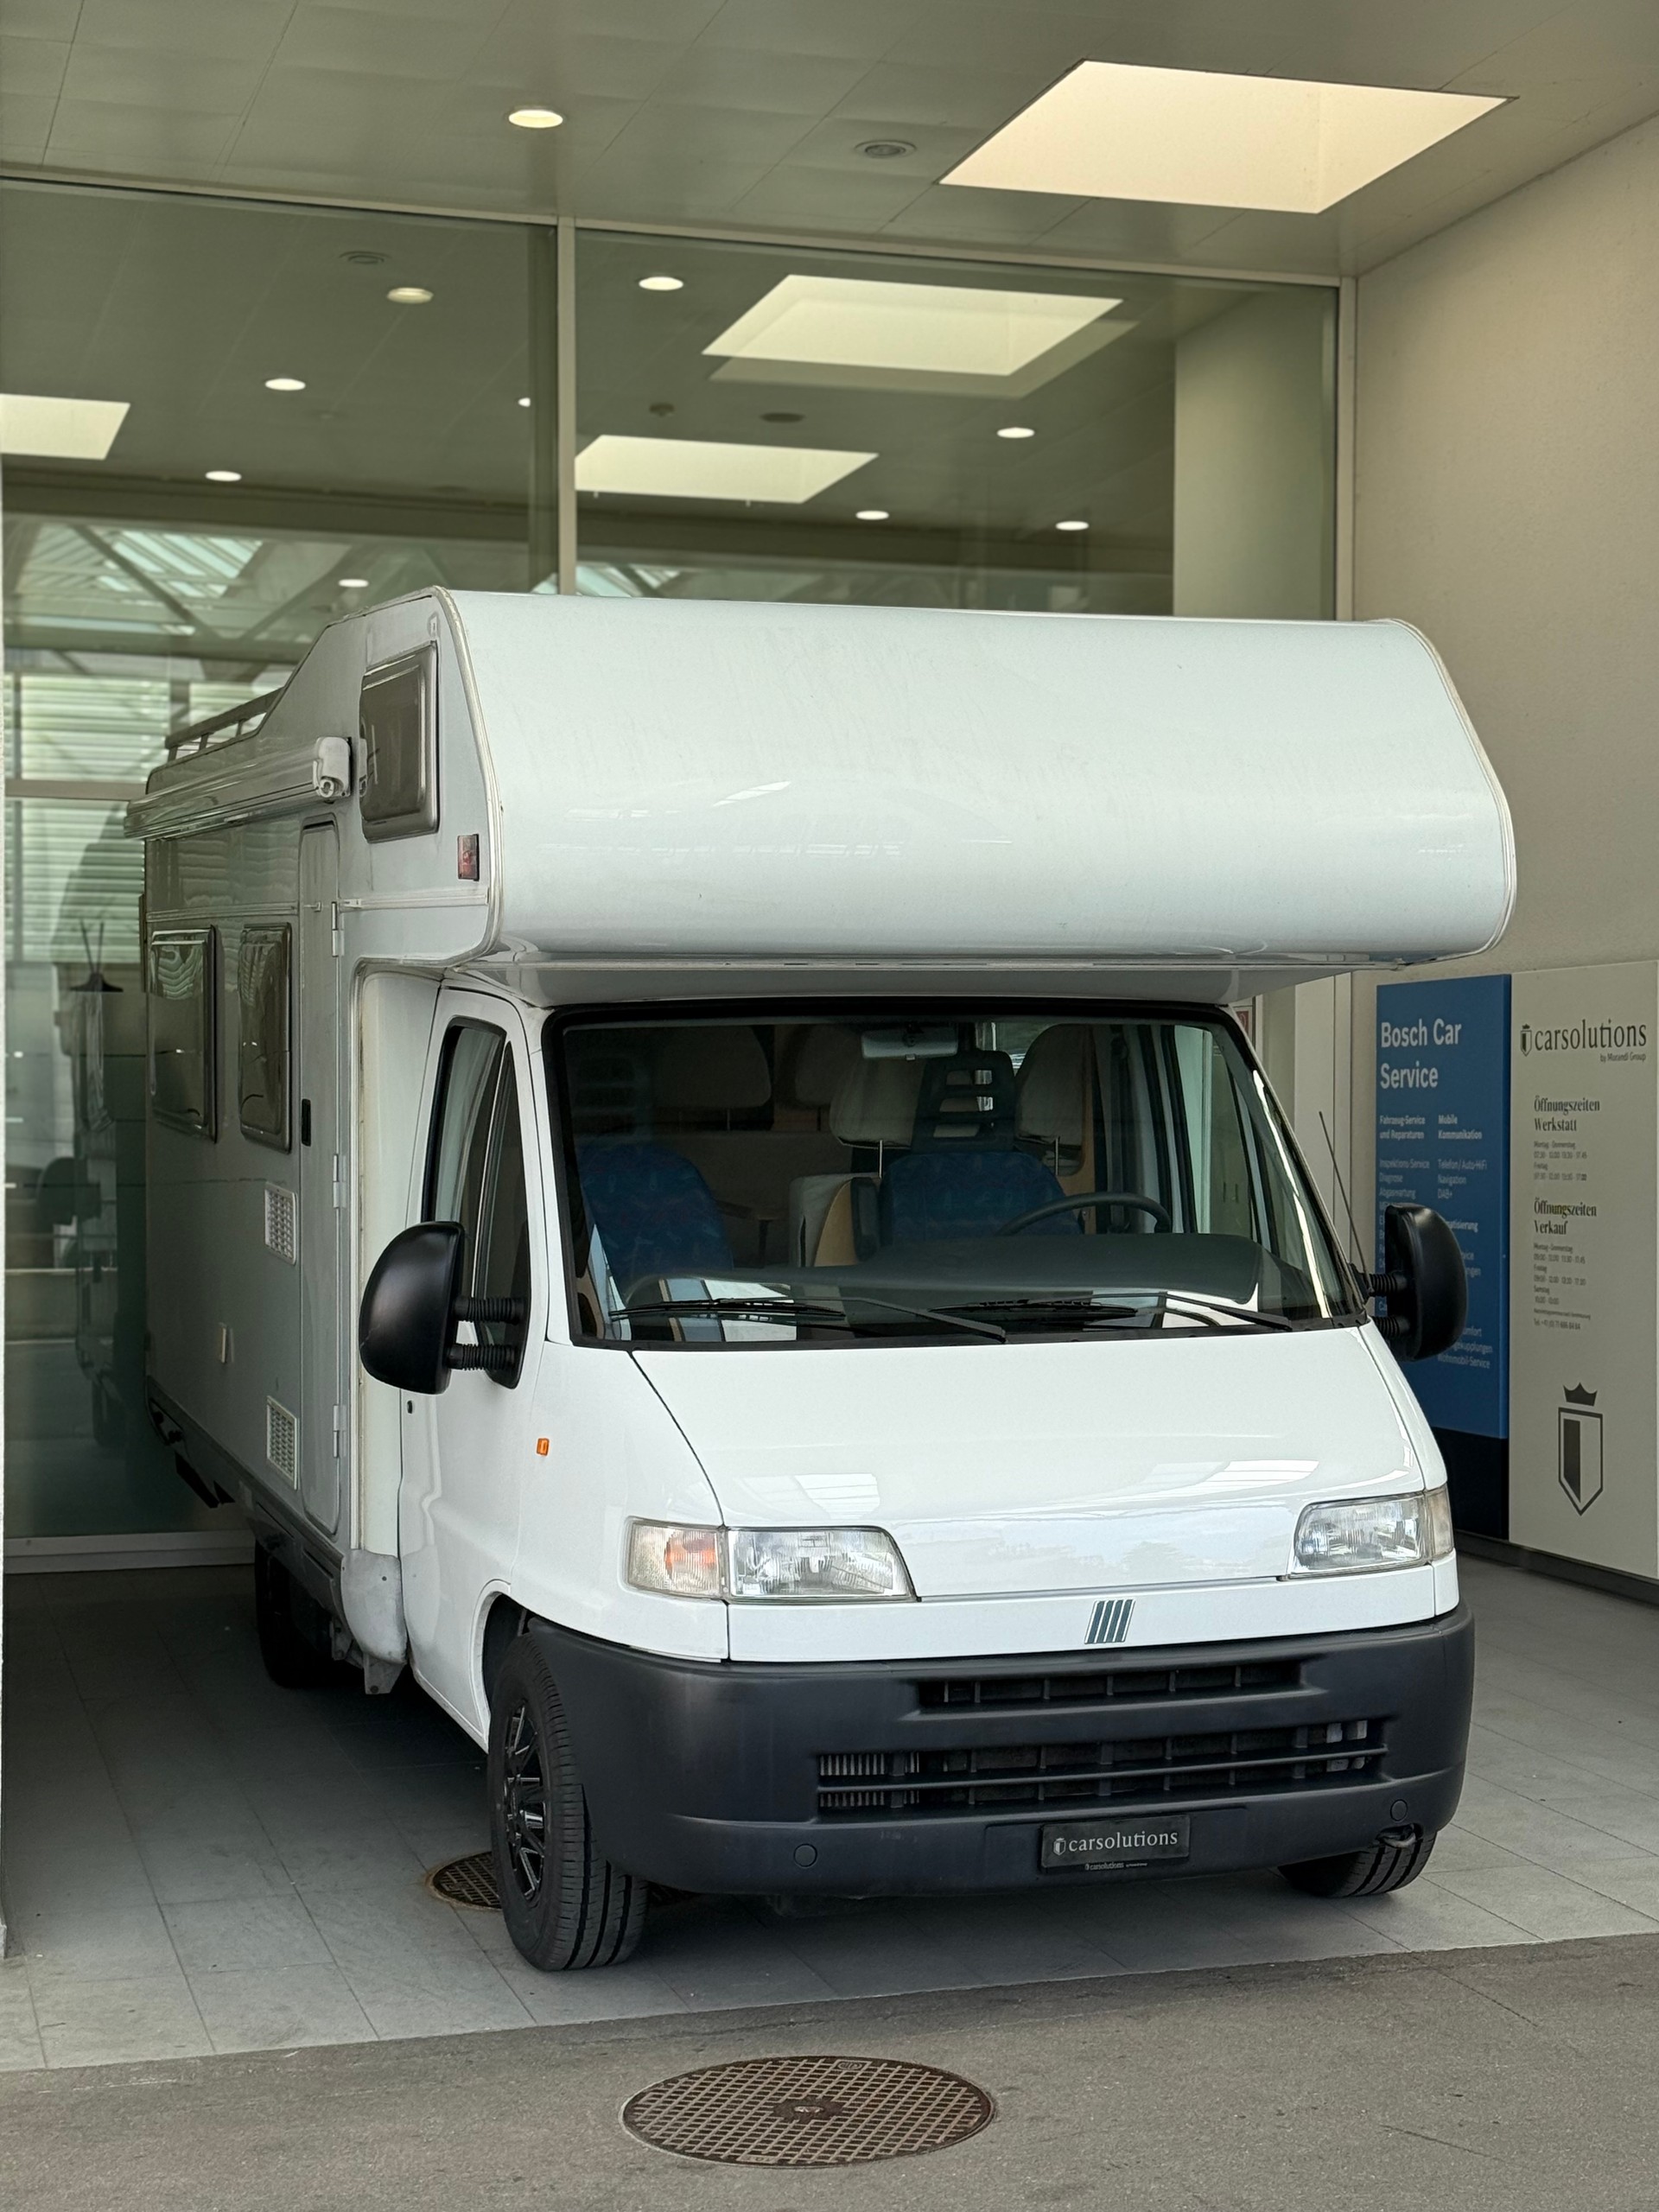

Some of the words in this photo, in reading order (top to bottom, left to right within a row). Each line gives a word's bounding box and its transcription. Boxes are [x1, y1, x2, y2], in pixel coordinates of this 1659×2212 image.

[1381, 1018, 1427, 1047] Bosch
[1433, 1018, 1462, 1046] Car
[1535, 1018, 1647, 1051] carsolutions
[1630, 1052, 1646, 1063] Group
[1381, 1060, 1438, 1089] Service
[1535, 1096, 1600, 1116] Öffnungszeiten
[1380, 1115, 1426, 1127] Fahrzeug-Service
[1438, 1115, 1458, 1124] Mobile
[1535, 1117, 1577, 1131] Werkstatt
[1380, 1129, 1389, 1139] und
[1391, 1130, 1424, 1140] Reparaturen
[1438, 1129, 1483, 1139] Kommunikation
[1438, 1173, 1466, 1186] Navigation
[1535, 1197, 1597, 1219] Öffnungszeiten
[1535, 1220, 1568, 1235] Verkauf
[1069, 1830, 1179, 1852] carsolutions
[1090, 1861, 1123, 1871] carsolutions
